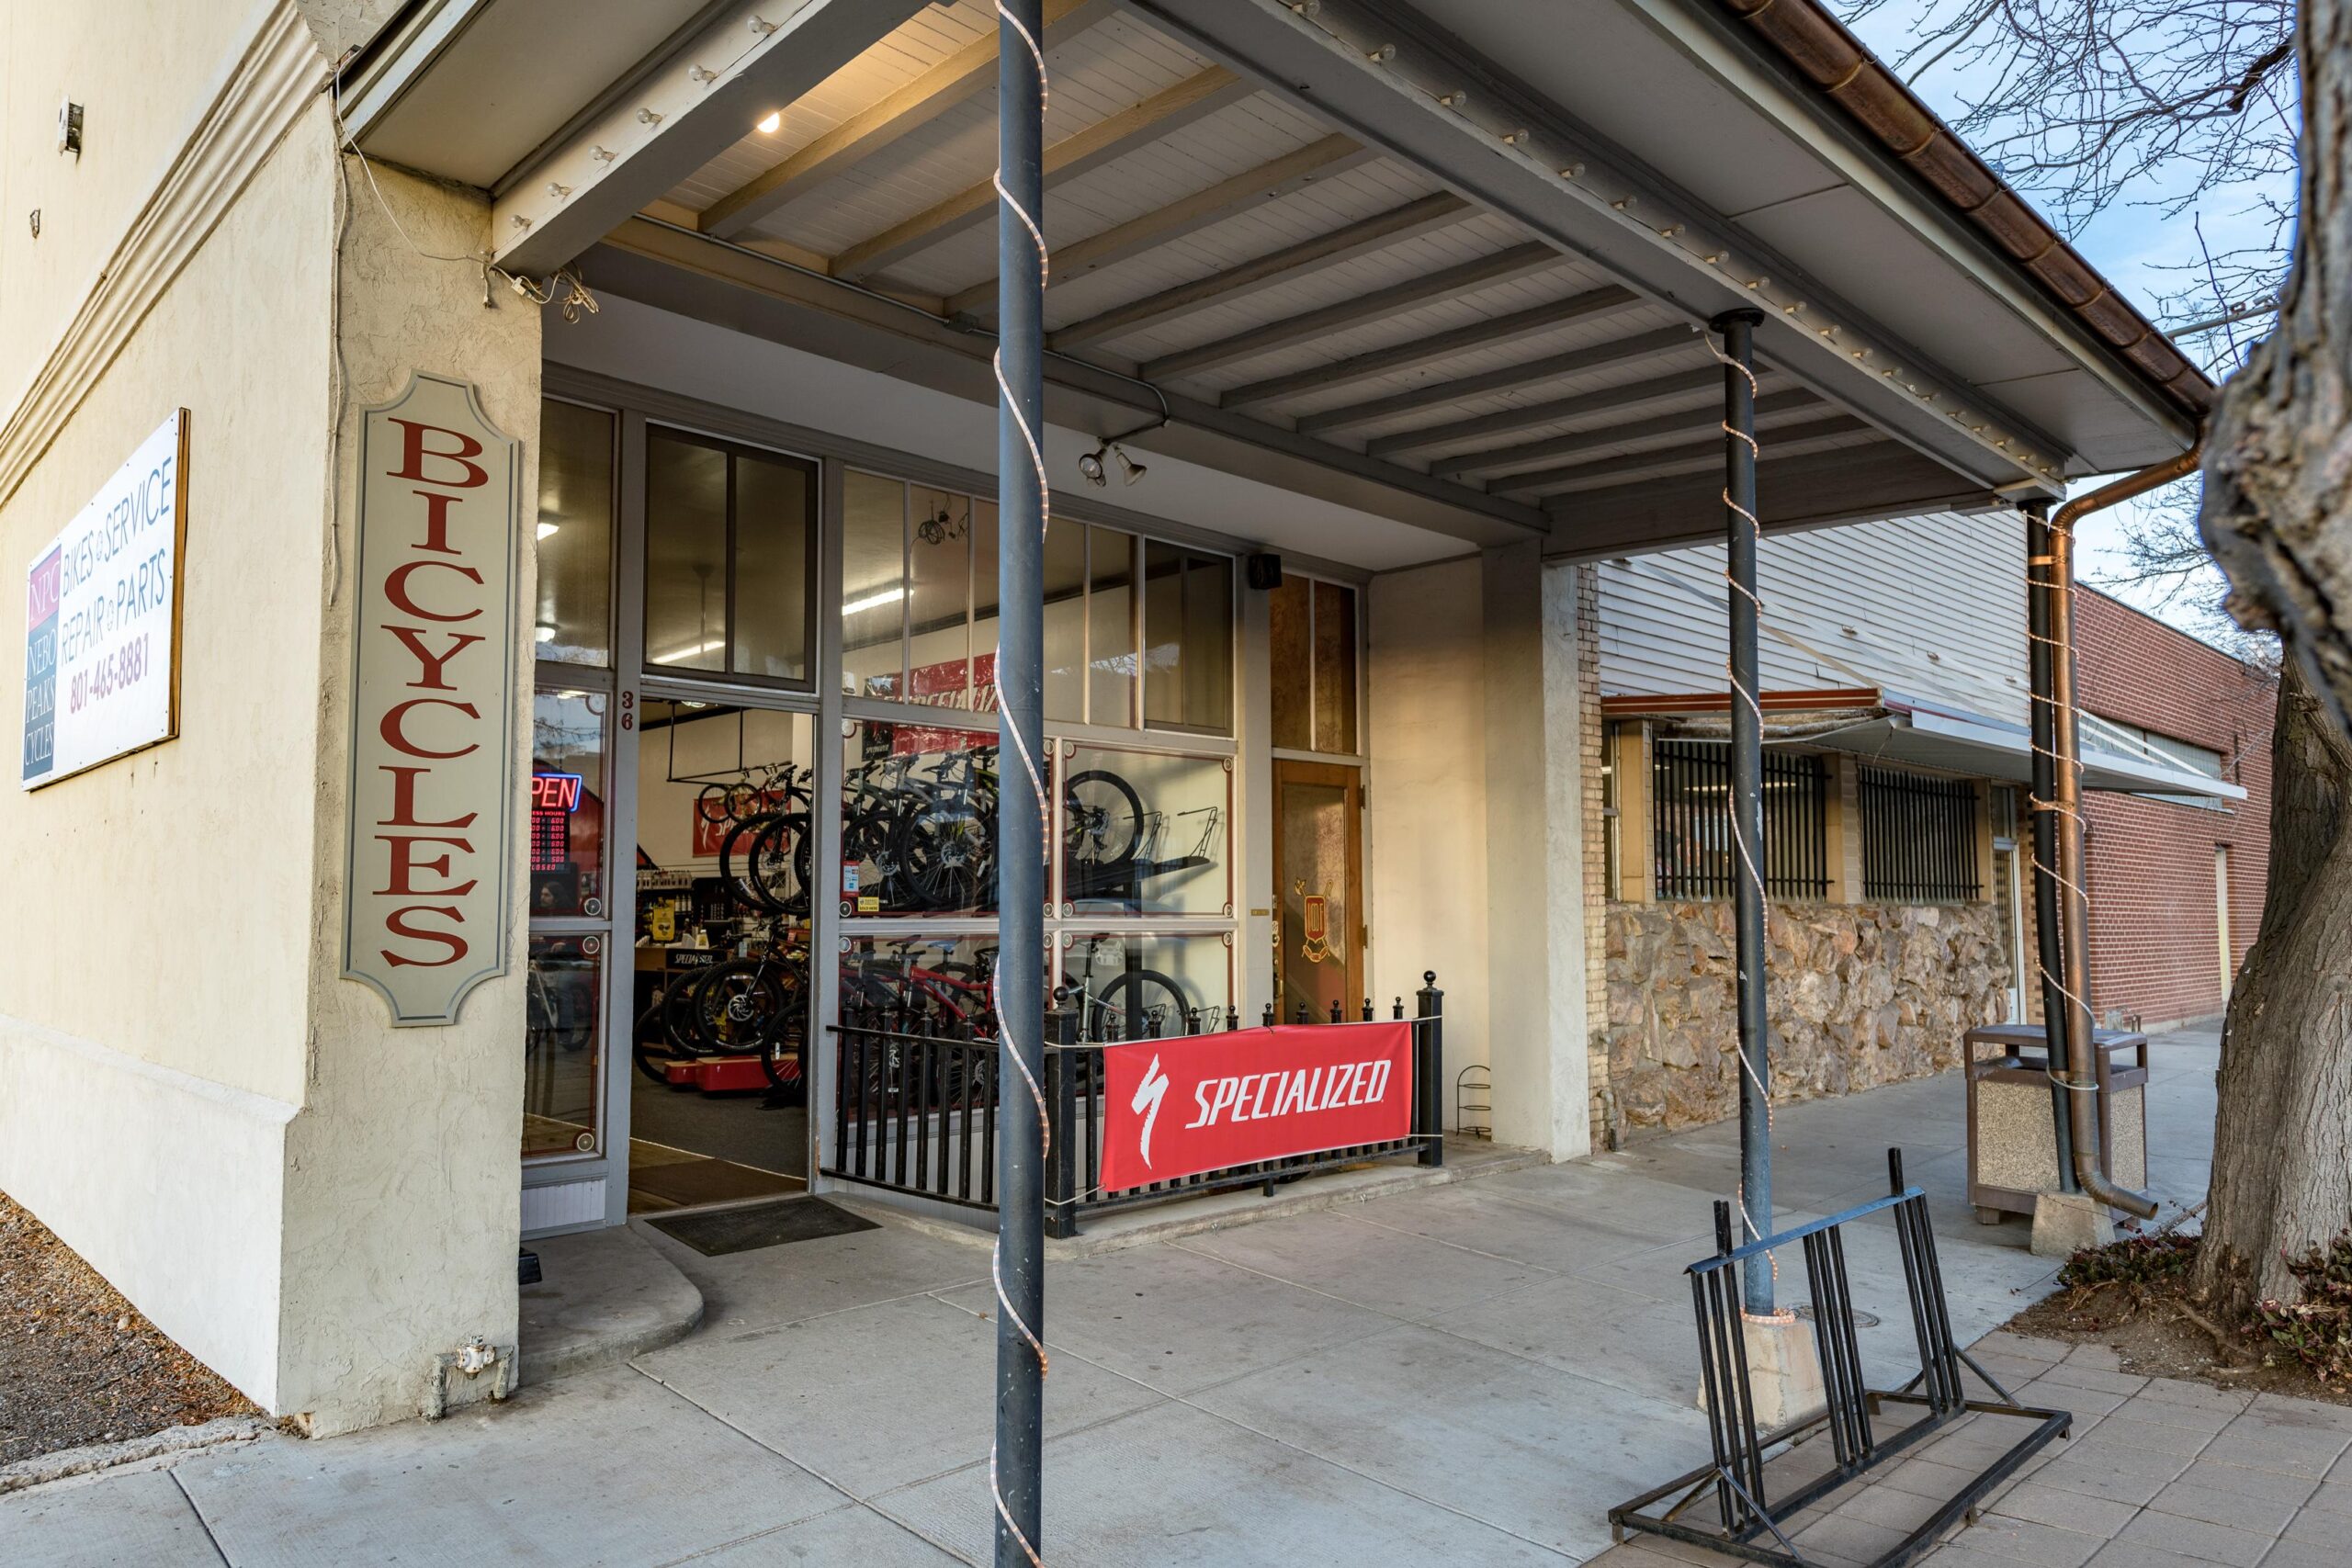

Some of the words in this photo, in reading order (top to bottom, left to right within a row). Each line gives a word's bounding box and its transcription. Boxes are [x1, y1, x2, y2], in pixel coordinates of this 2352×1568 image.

[62, 530, 94, 598] BIKES
[104, 456, 172, 563] SERVICE
[30, 560, 61, 622] NPC
[61, 595, 105, 668] REPAIR
[117, 547, 166, 631] PARTS
[28, 628, 57, 681] NEBO
[70, 632, 149, 715] 801-465-8881
[26, 674, 56, 724] PEAKS
[371, 417, 489, 968] BICYCLES
[621, 690, 634, 731] 36
[25, 722, 54, 766] CYCLES
[531, 777, 577, 807] PEN
[1184, 1059, 1392, 1130] SPECIALIZED
